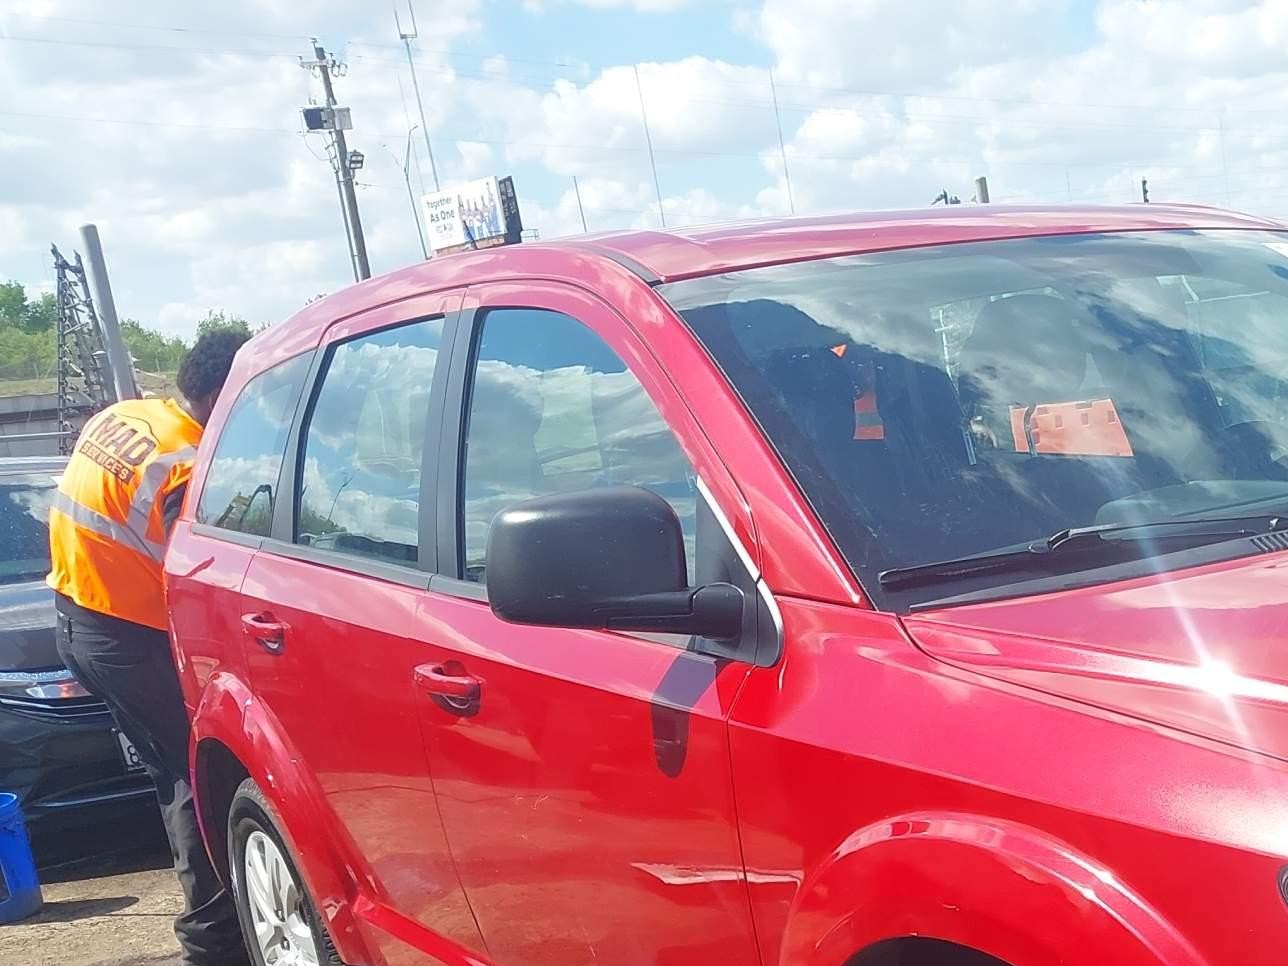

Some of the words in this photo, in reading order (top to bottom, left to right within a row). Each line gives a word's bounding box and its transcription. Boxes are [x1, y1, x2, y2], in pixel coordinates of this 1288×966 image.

[426, 197, 452, 211] Together
[430, 213, 440, 224] As
[440, 209, 455, 220] One
[81, 442, 129, 480] SERVICES
